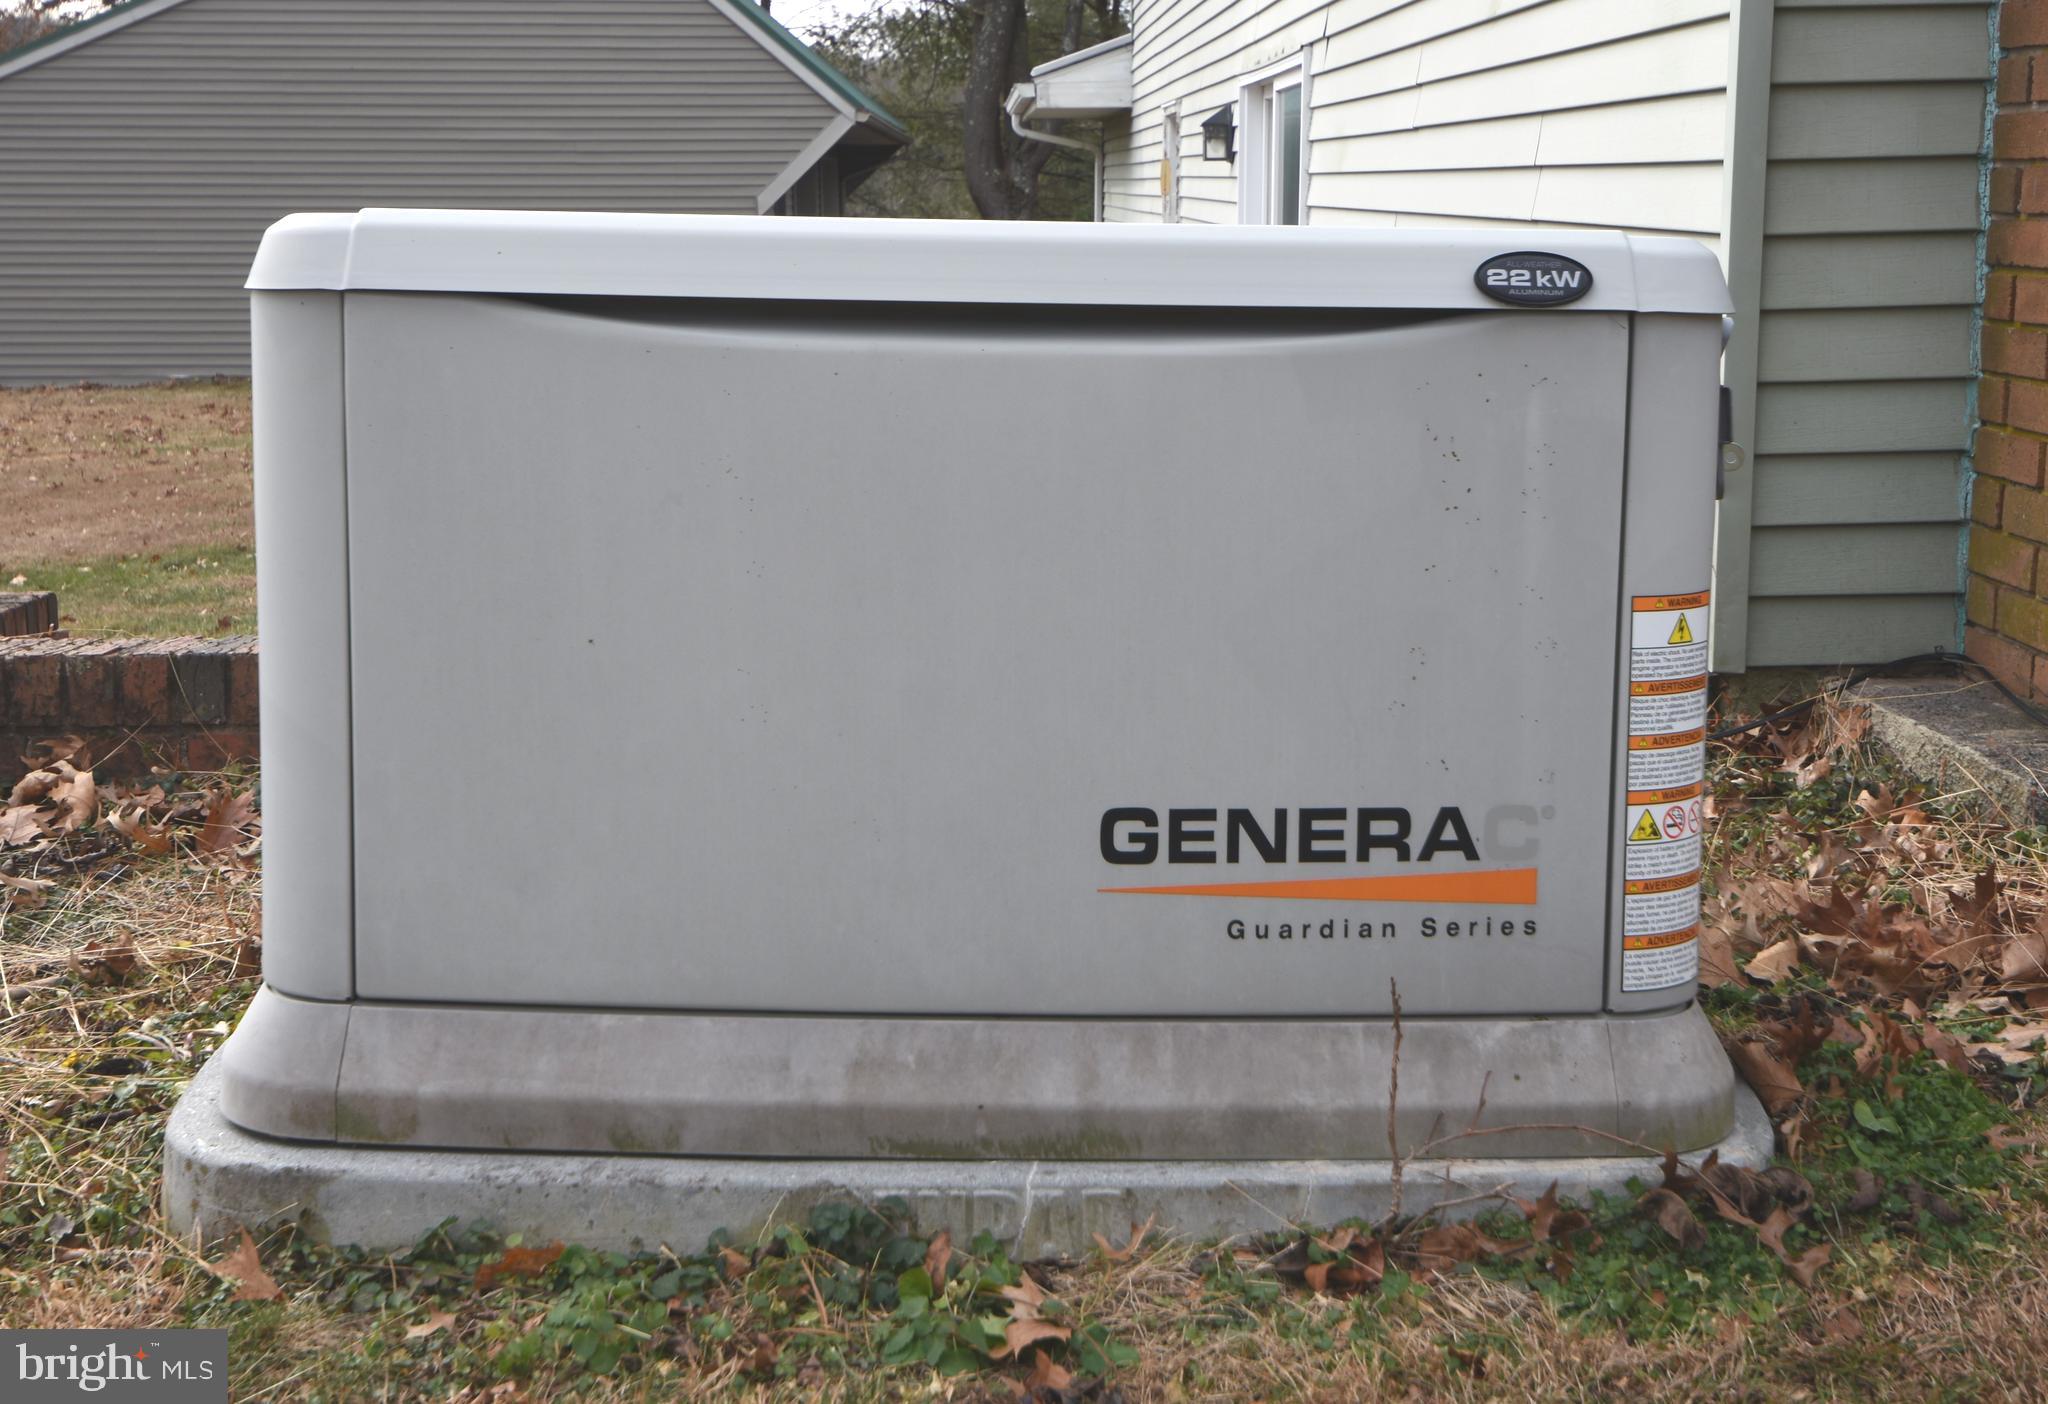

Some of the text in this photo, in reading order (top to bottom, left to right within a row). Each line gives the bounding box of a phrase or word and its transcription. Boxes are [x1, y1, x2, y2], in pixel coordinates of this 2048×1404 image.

[1486, 268, 1582, 288] 22 kW
[1508, 288, 1564, 297] ALUMINUM
[1099, 804, 1540, 865] GENERAC
[1643, 872, 1697, 891] AVERTISS
[1226, 916, 1538, 940] Guardian Series
[1647, 927, 1696, 945] ADVERTEN
